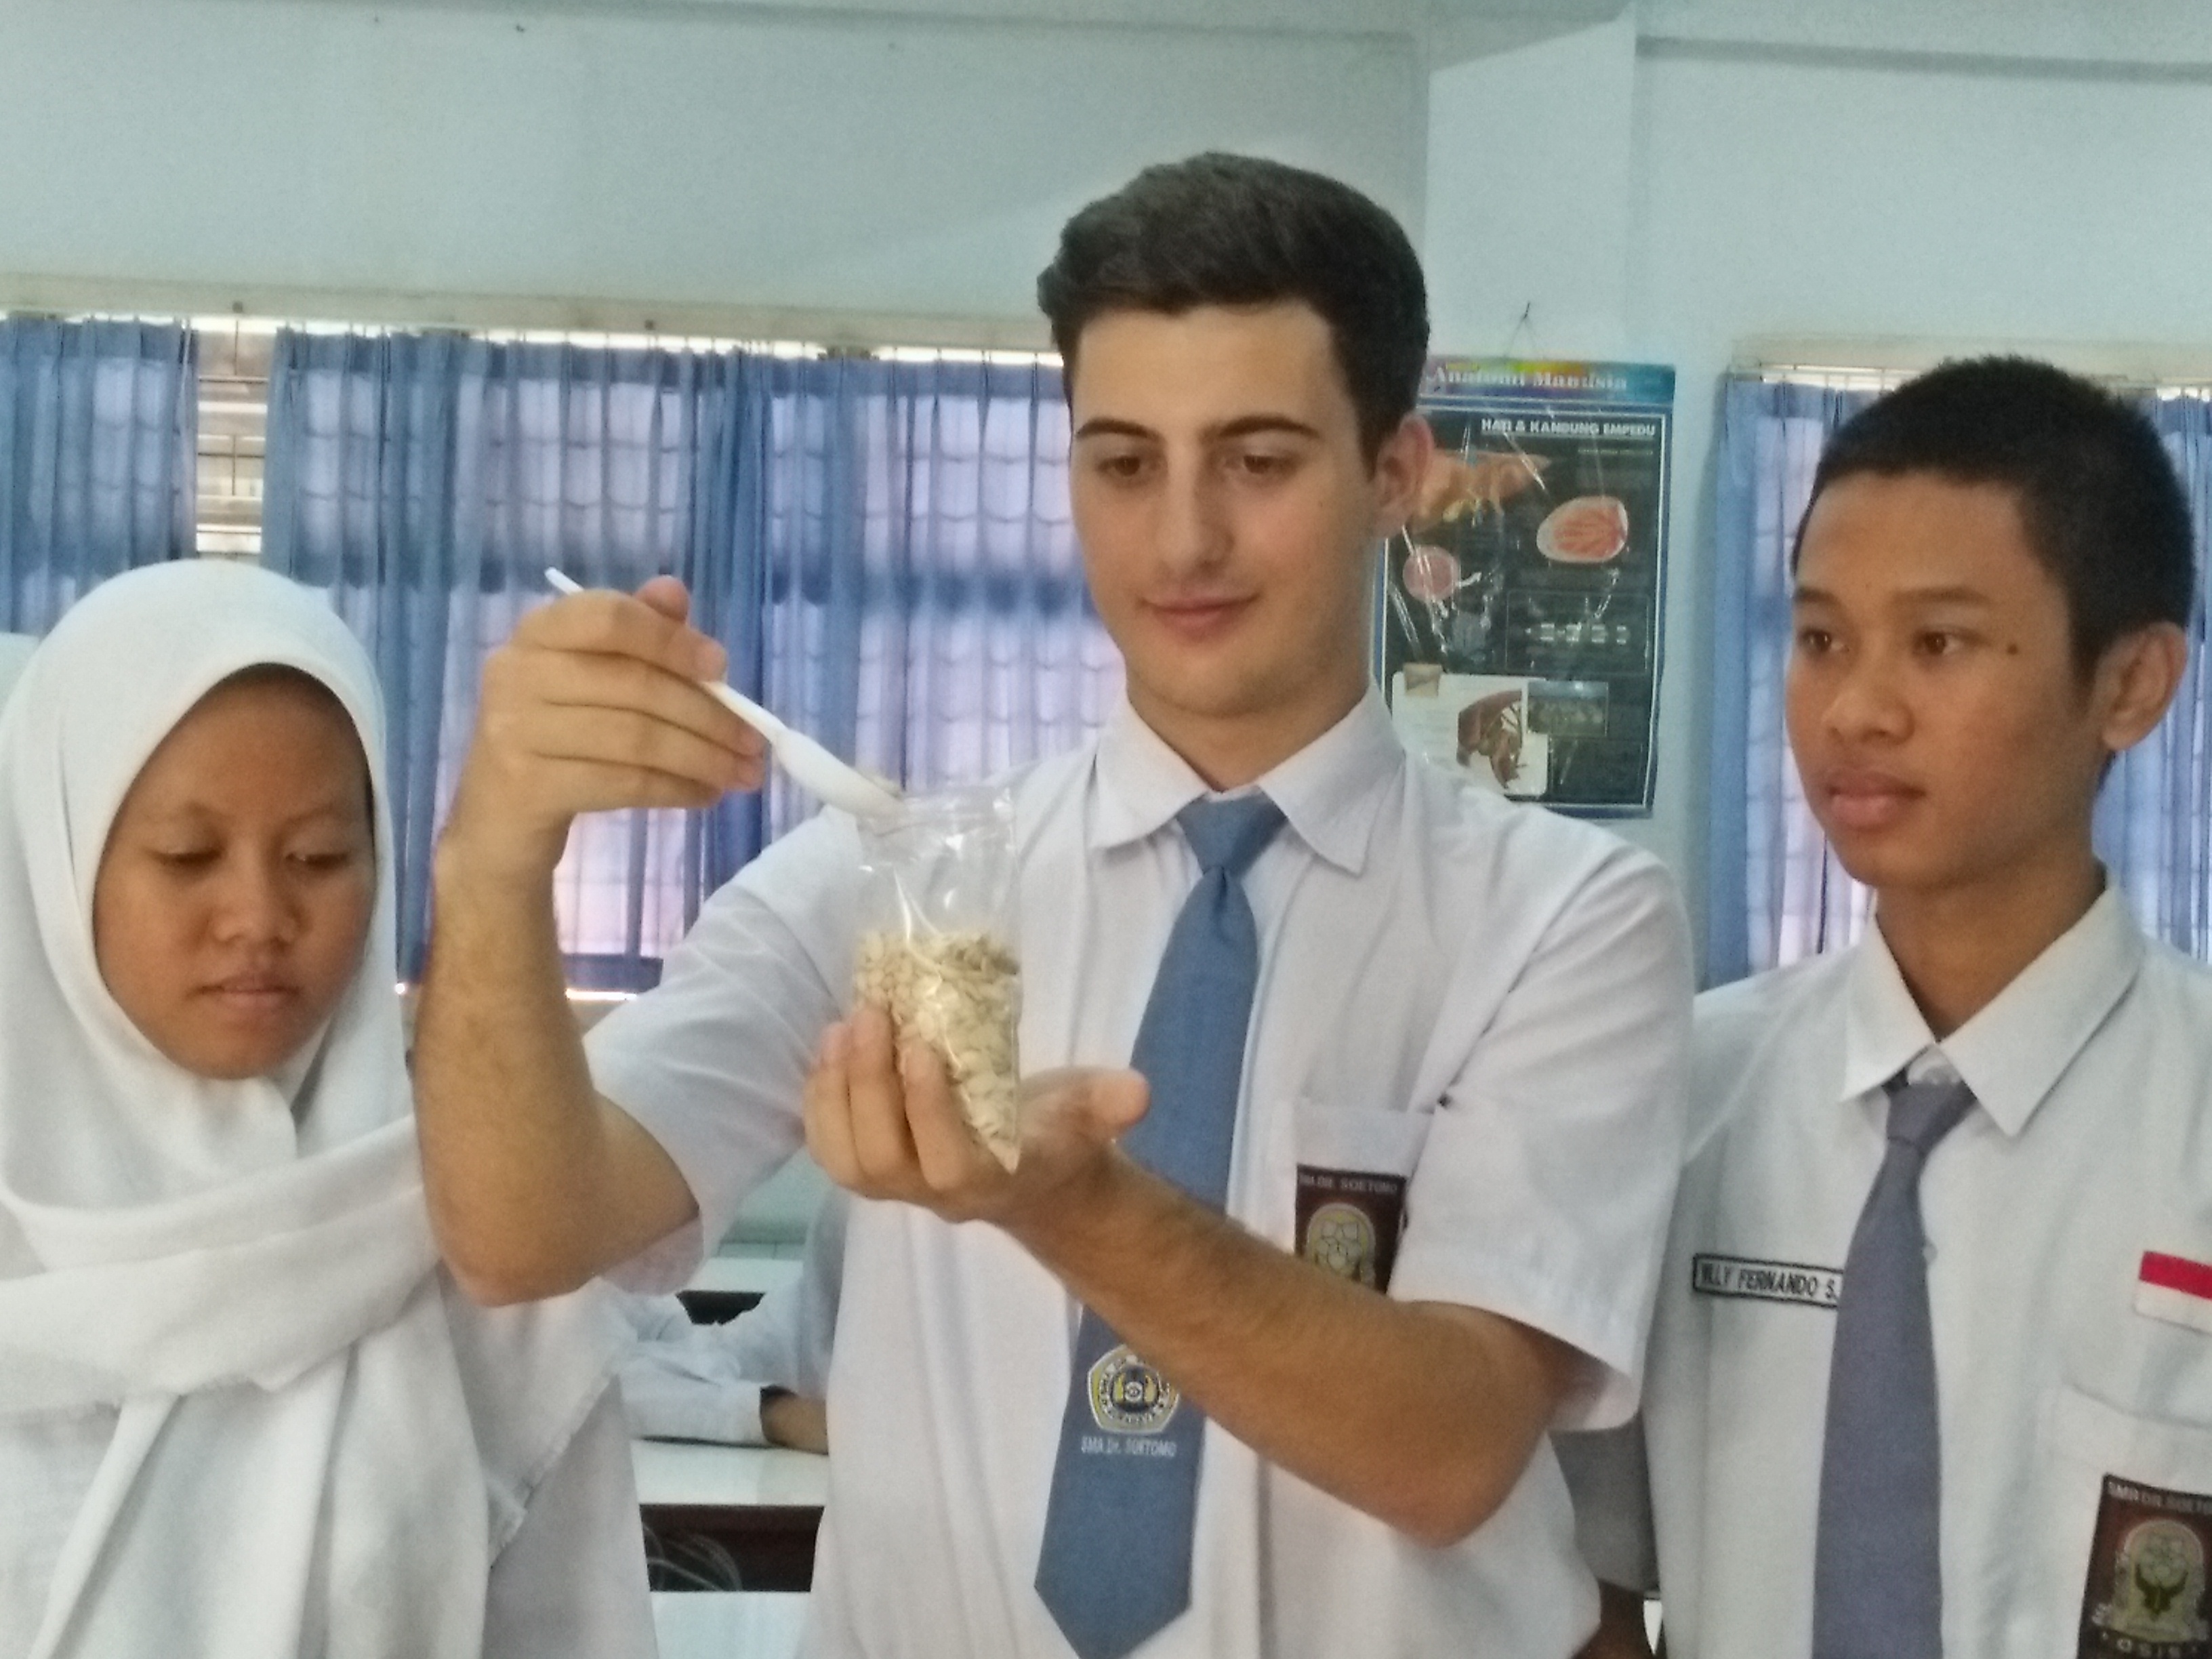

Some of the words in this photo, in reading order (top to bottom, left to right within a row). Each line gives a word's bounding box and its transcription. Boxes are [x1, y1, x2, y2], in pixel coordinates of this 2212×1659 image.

[1533, 371, 1627, 389] Manusia
[1481, 418, 1512, 432] HATI
[1530, 419, 1599, 435] KANDUNG
[1603, 422, 1656, 437] EMPEDU
[1738, 1269, 1818, 1297] FERNANDO
